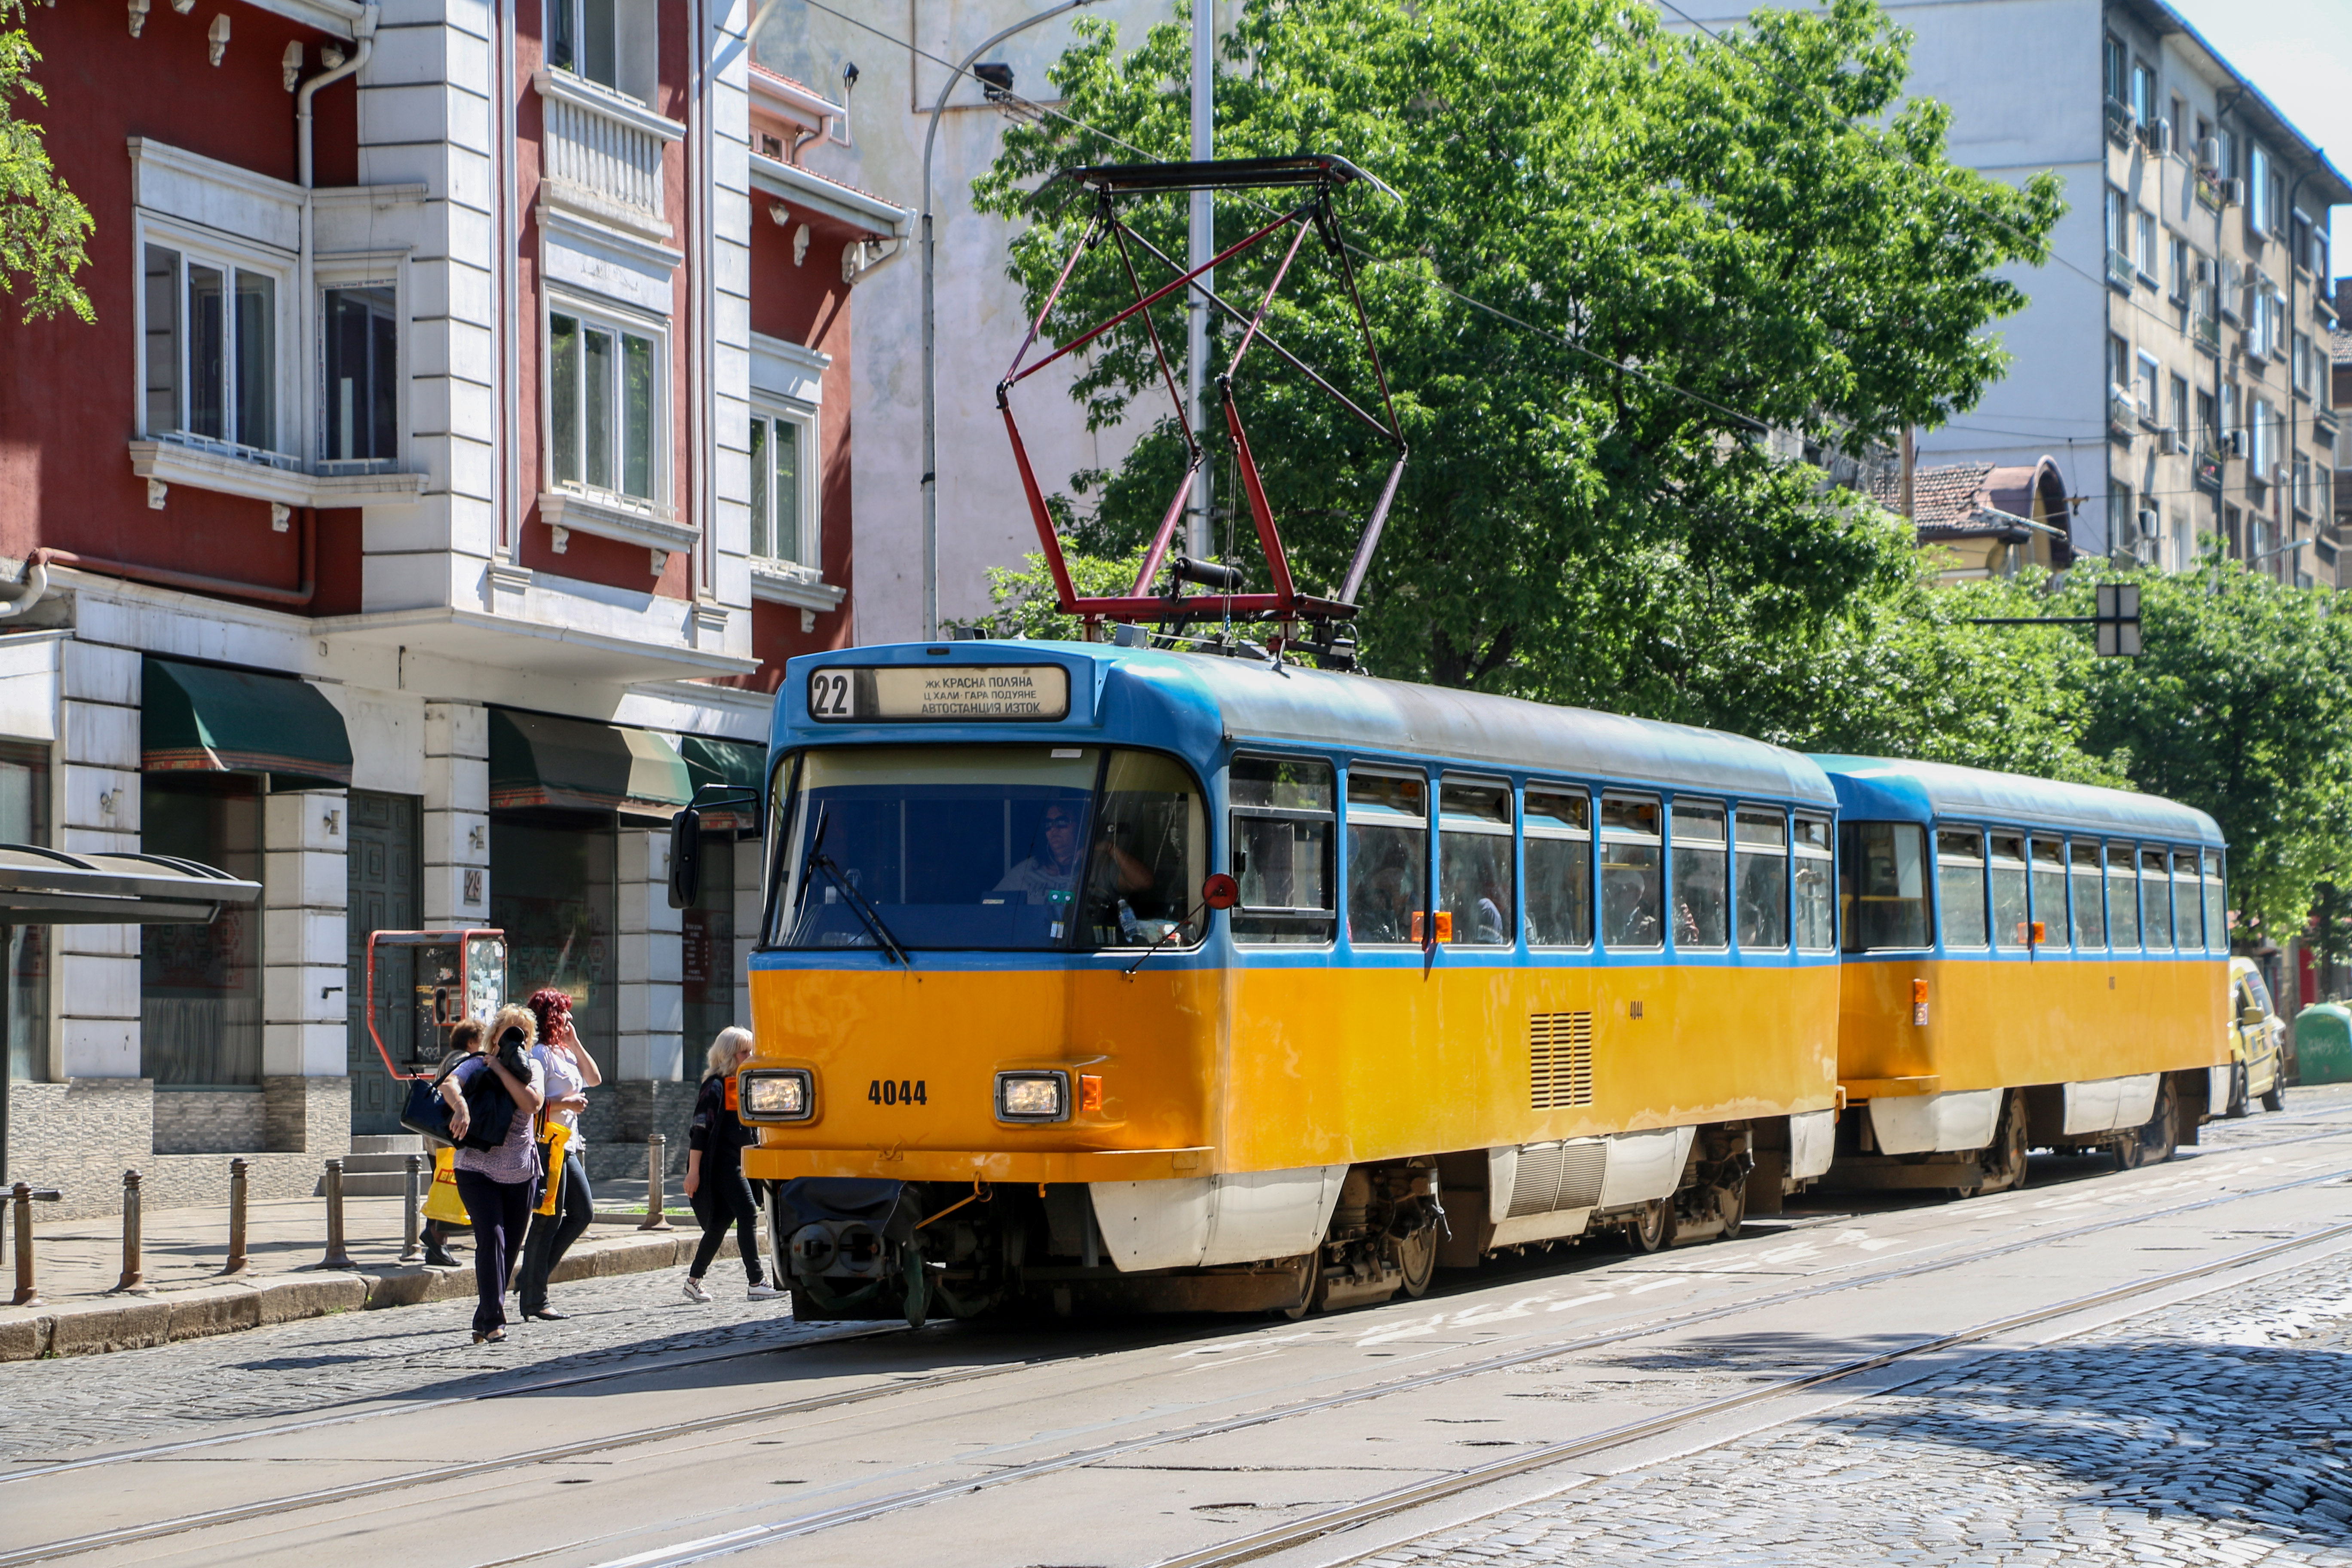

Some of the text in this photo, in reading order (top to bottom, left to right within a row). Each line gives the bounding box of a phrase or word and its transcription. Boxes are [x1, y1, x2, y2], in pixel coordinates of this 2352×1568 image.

[943, 677, 986, 688] КРАСНА
[989, 677, 1033, 687] ПОЛЯНА
[814, 675, 848, 714] 22
[965, 691, 989, 699] ГАРА
[991, 690, 1037, 700] ПОДУЯНЕ
[922, 702, 1040, 715] АВТОСТАНЦИЯ ИЗТОК
[468, 870, 481, 897] 29
[1630, 1000, 1643, 1020] 4044
[868, 1080, 927, 1105] 4044
